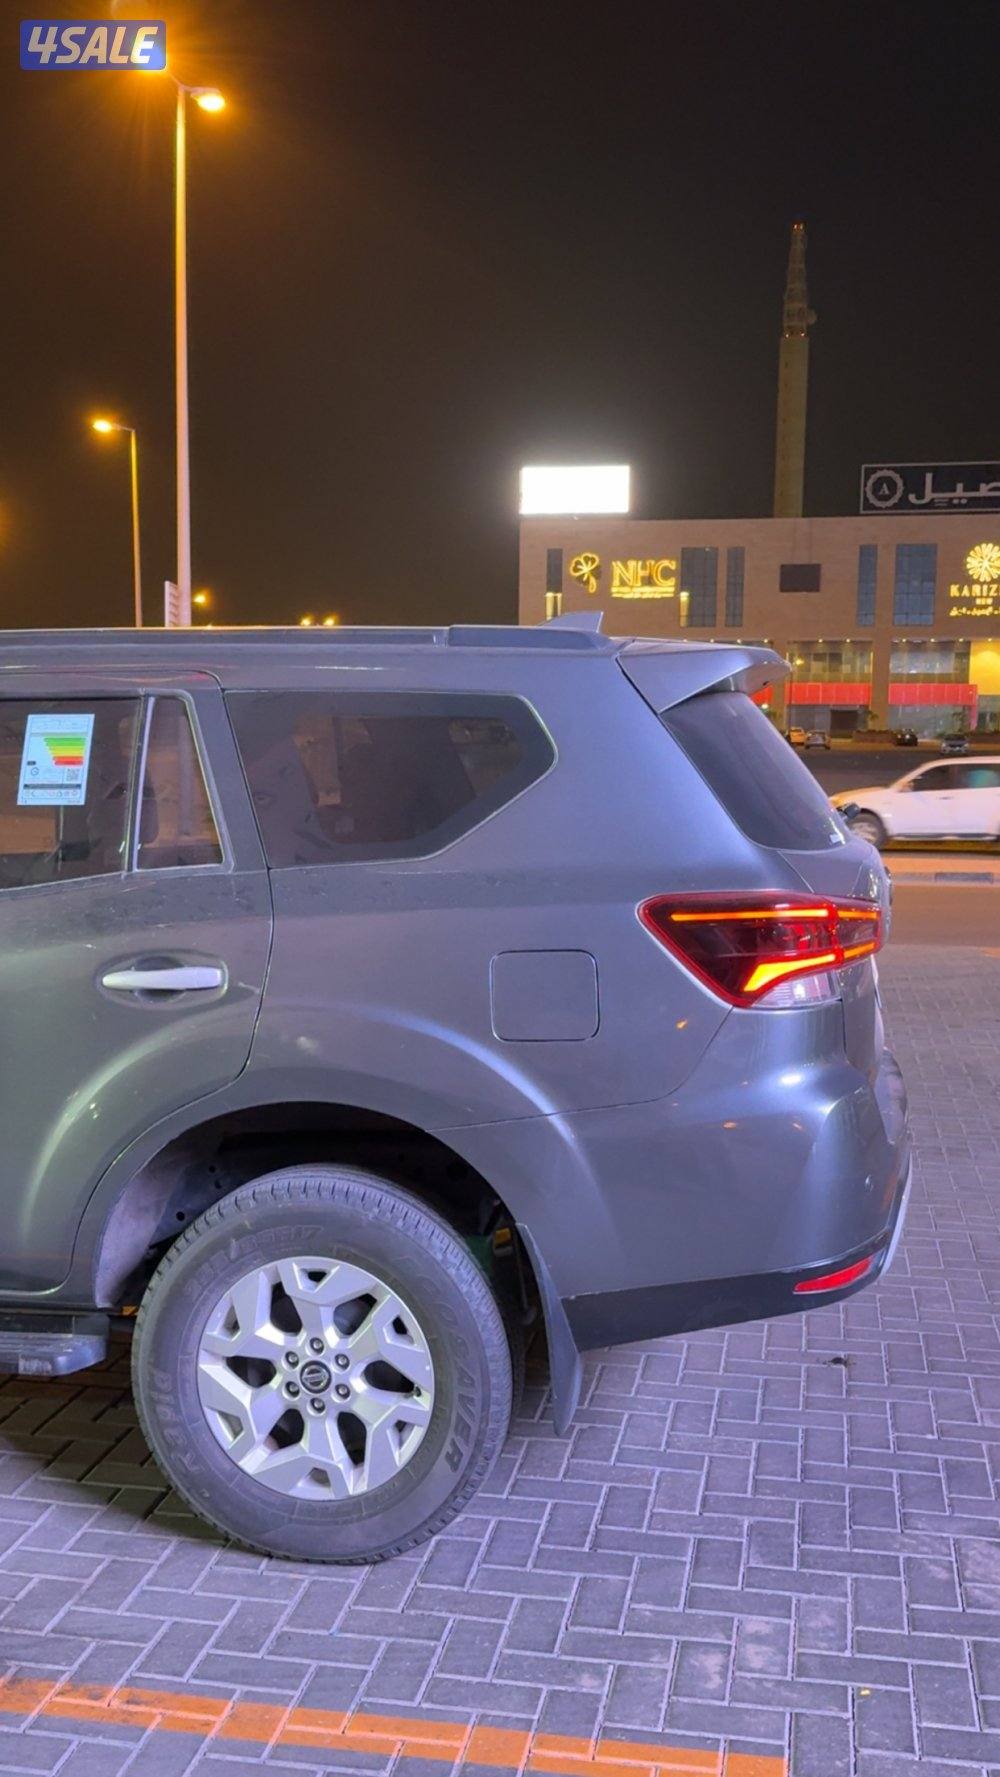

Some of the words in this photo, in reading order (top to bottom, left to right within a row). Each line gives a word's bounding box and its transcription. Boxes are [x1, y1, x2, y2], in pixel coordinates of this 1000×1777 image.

[879, 483, 890, 495] A
[611, 560, 676, 586] NHC
[950, 584, 1000, 597] KARIZ
